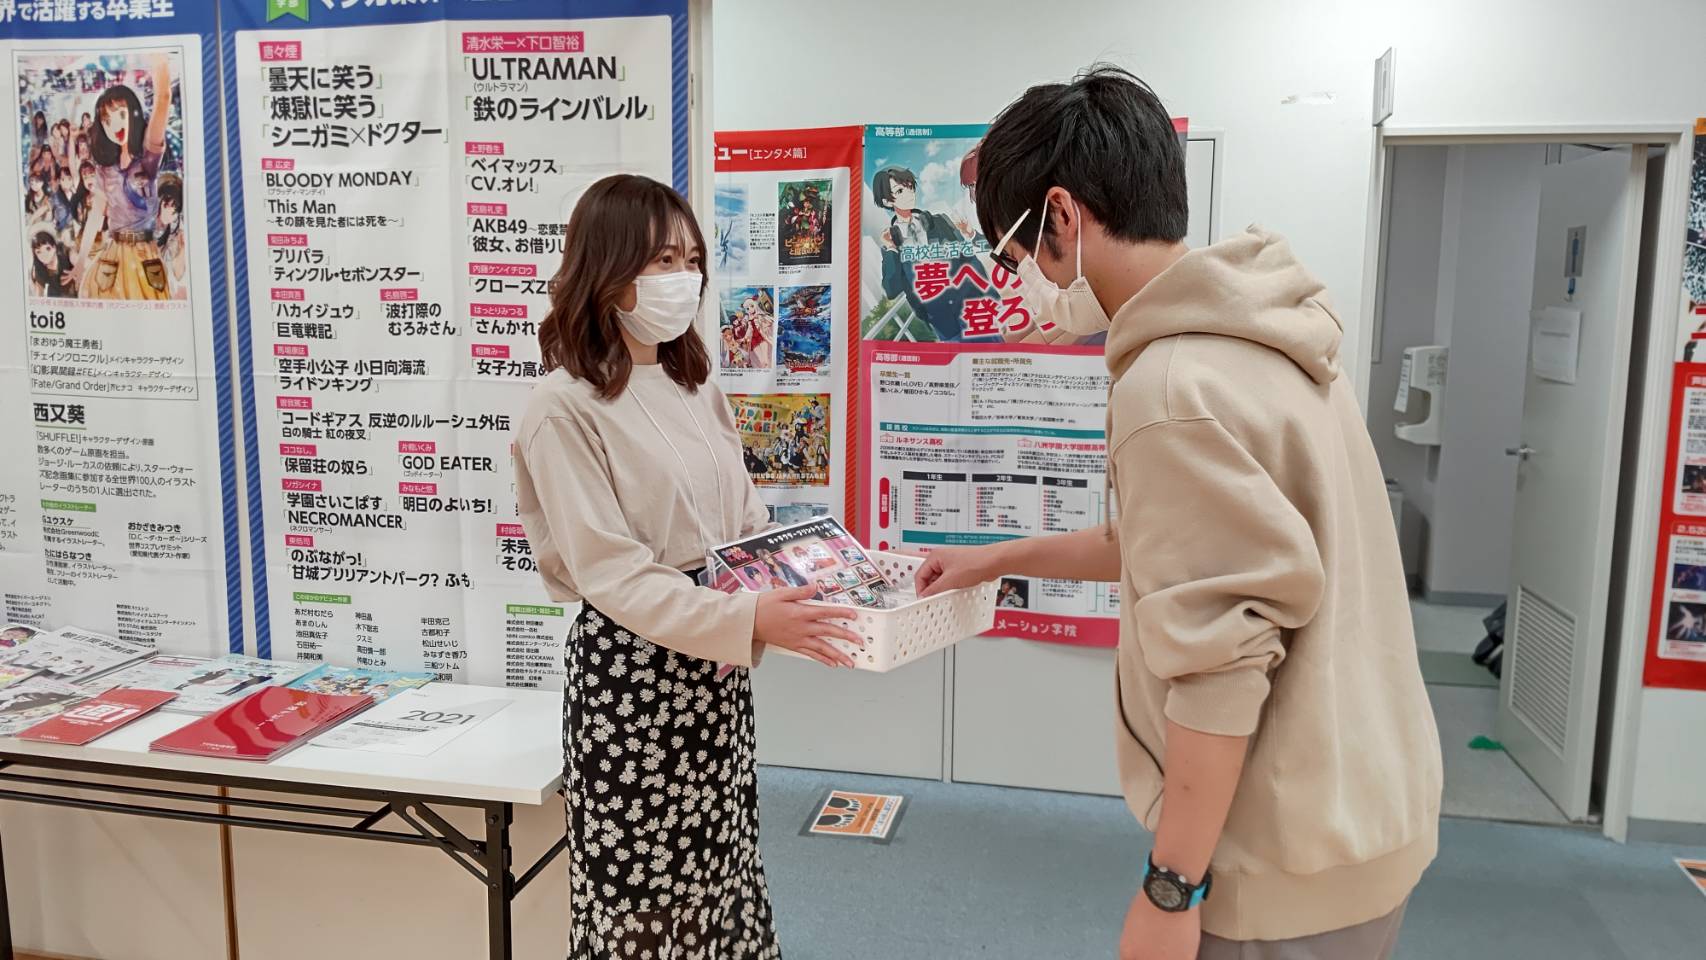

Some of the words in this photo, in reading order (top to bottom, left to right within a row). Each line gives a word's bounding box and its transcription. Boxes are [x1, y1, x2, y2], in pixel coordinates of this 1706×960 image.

[466, 36, 579, 51] 清水栄一×下口智裕
[465, 95, 655, 121] 「鉄のラインバレル」
[302, 200, 336, 214] Man
[30, 311, 66, 329] toi8
[33, 402, 85, 424] 西又葵
[368, 412, 510, 431] 反逆のルルーシュ外伝
[282, 427, 322, 439] 白の騎士
[997, 619, 1078, 638] メーション学院
[356, 635, 373, 643] クスミ
[422, 640, 459, 648] 松山せいじ
[400, 710, 476, 725] 2021
